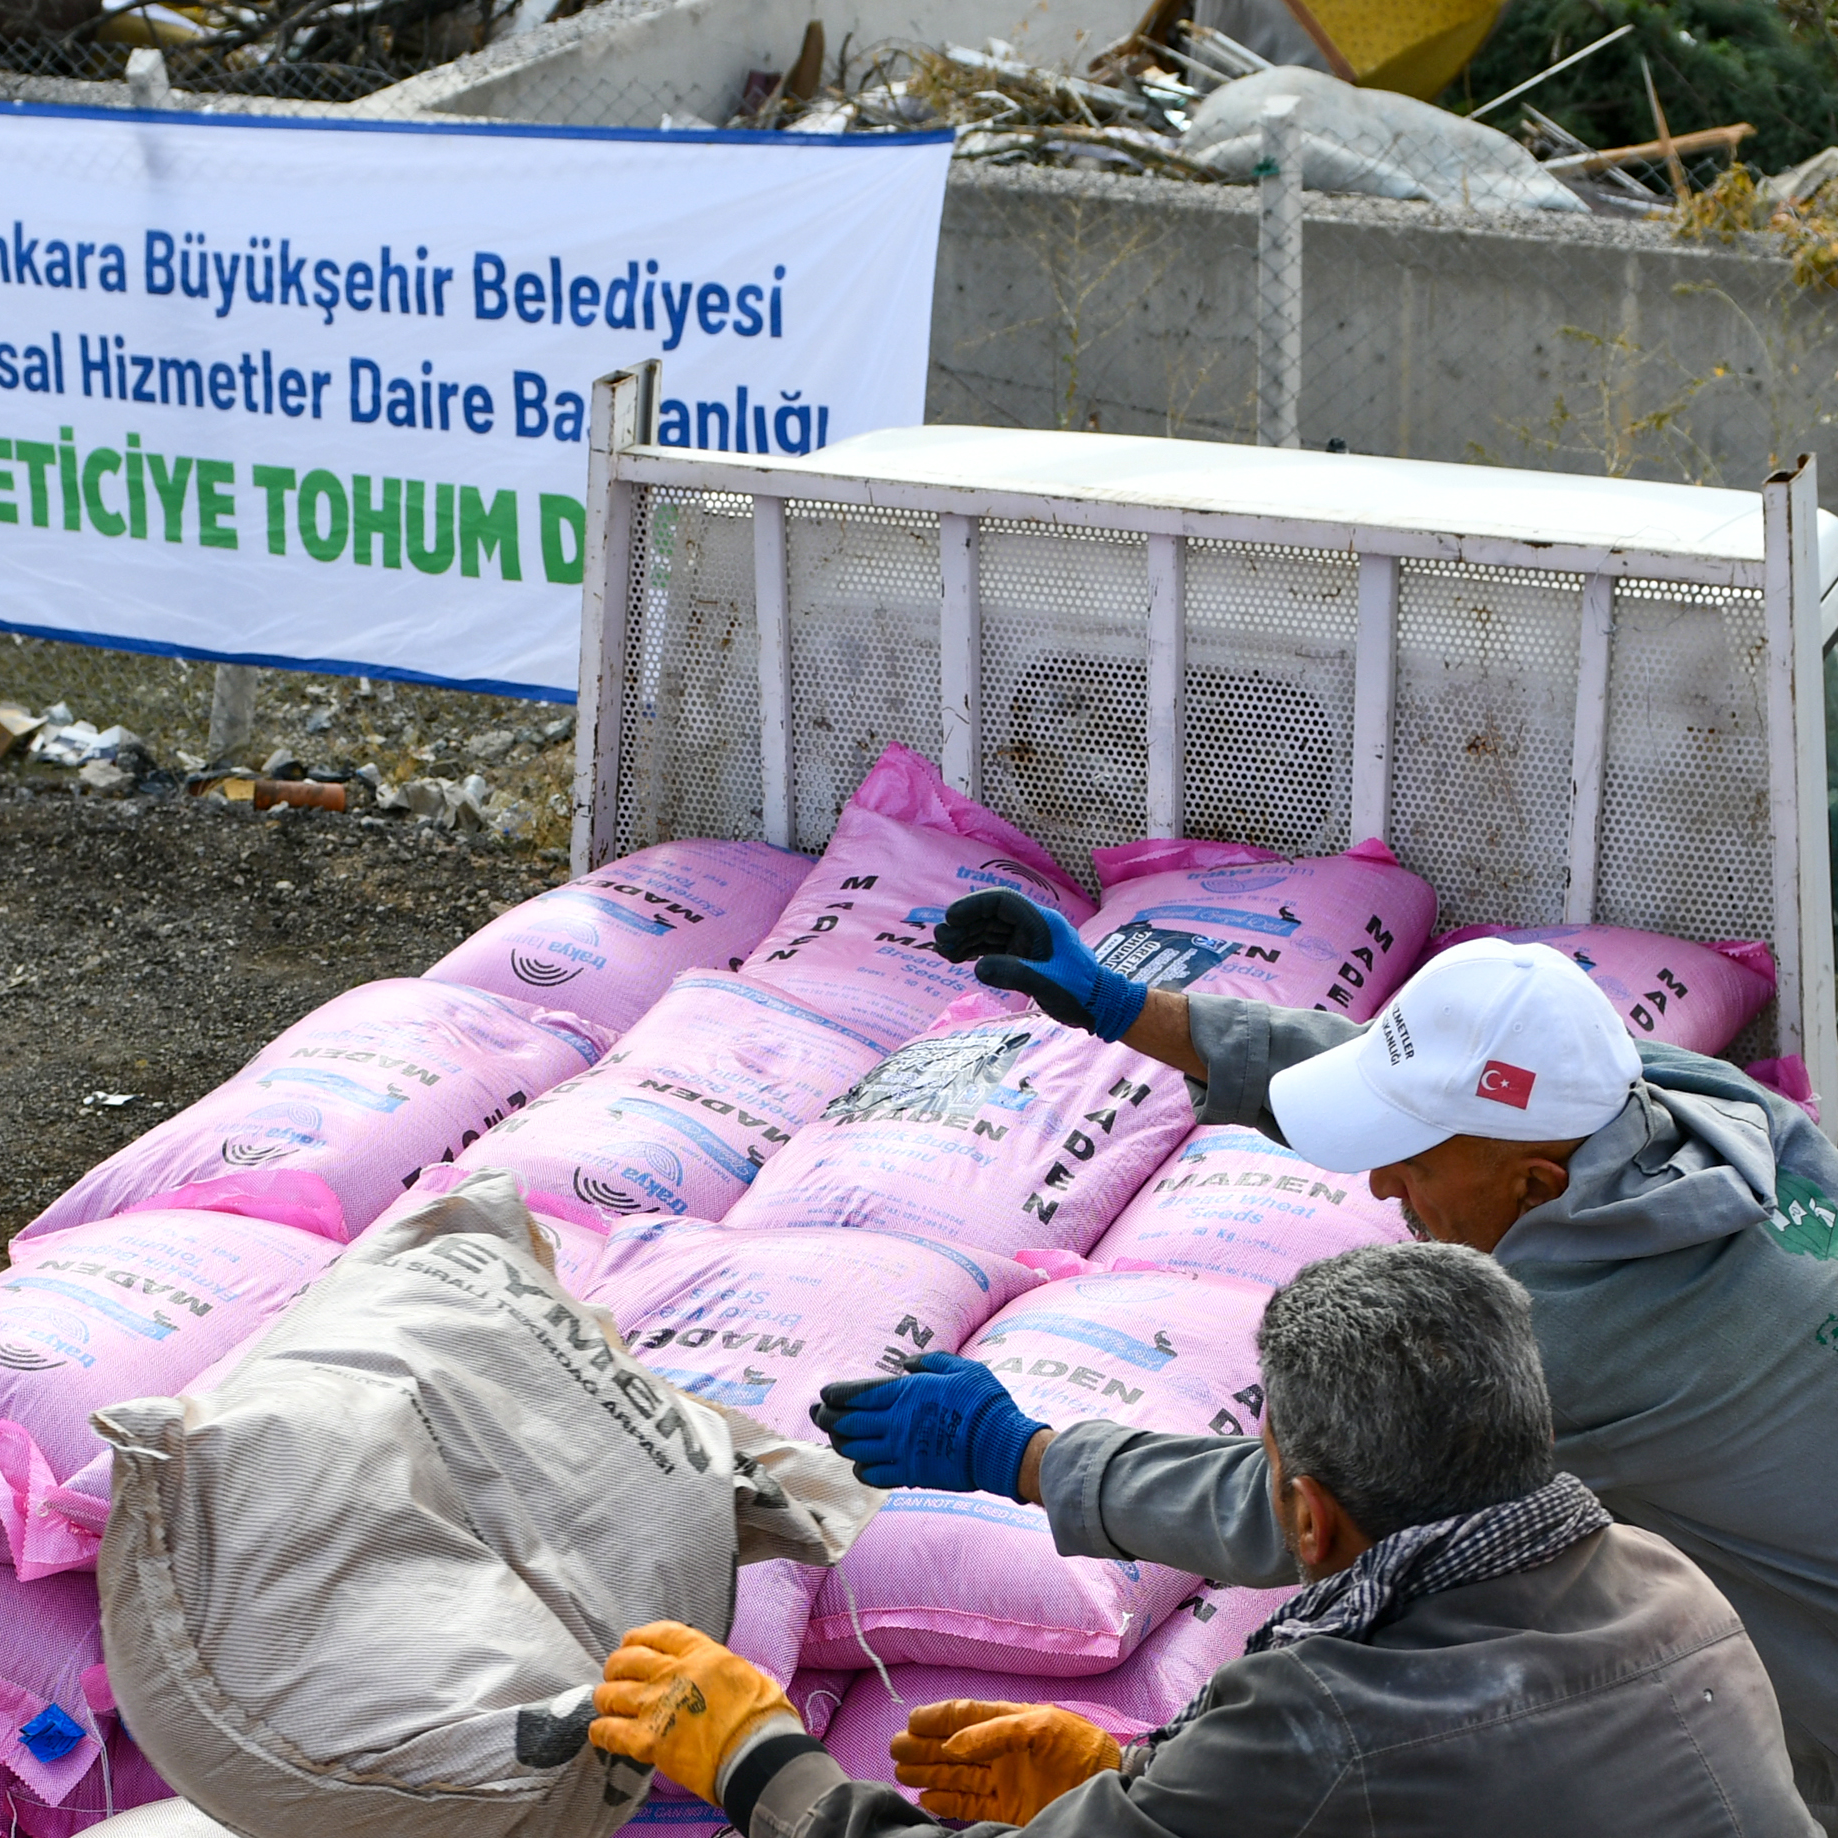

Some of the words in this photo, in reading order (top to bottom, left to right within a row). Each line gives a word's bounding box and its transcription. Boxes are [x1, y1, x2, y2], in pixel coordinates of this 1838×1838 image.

[145, 229, 455, 326] Büyükşehir
[472, 252, 787, 351] Belediyesi
[78, 333, 332, 420] Hizmetler
[349, 355, 495, 435] Daire
[513, 368, 831, 457] Baanlığı
[251, 463, 524, 582] TOHUM
[956, 865, 1023, 892] trakya
[1187, 867, 1253, 880] trakya
[548, 940, 608, 971] trakya
[876, 944, 944, 971] Bread
[900, 961, 968, 993] Seeds
[289, 1047, 442, 1087] MADEN
[833, 1108, 1010, 1142] MADEN
[913, 1130, 999, 1169] Buğday
[1021, 1076, 1152, 1226] MADEN
[620, 1165, 689, 1215] trakya
[1153, 1171, 1348, 1207] MADEN
[1241, 1192, 1317, 1220] Wheat
[1187, 1208, 1264, 1225] Seeds
[36, 1258, 214, 1318] MADEN
[406, 1261, 490, 1300] SIRALI
[989, 1356, 1146, 1406] ADEN
[924, 1497, 951, 1509] NOT
[953, 1500, 974, 1511] BE
[974, 1503, 1009, 1519] USED
